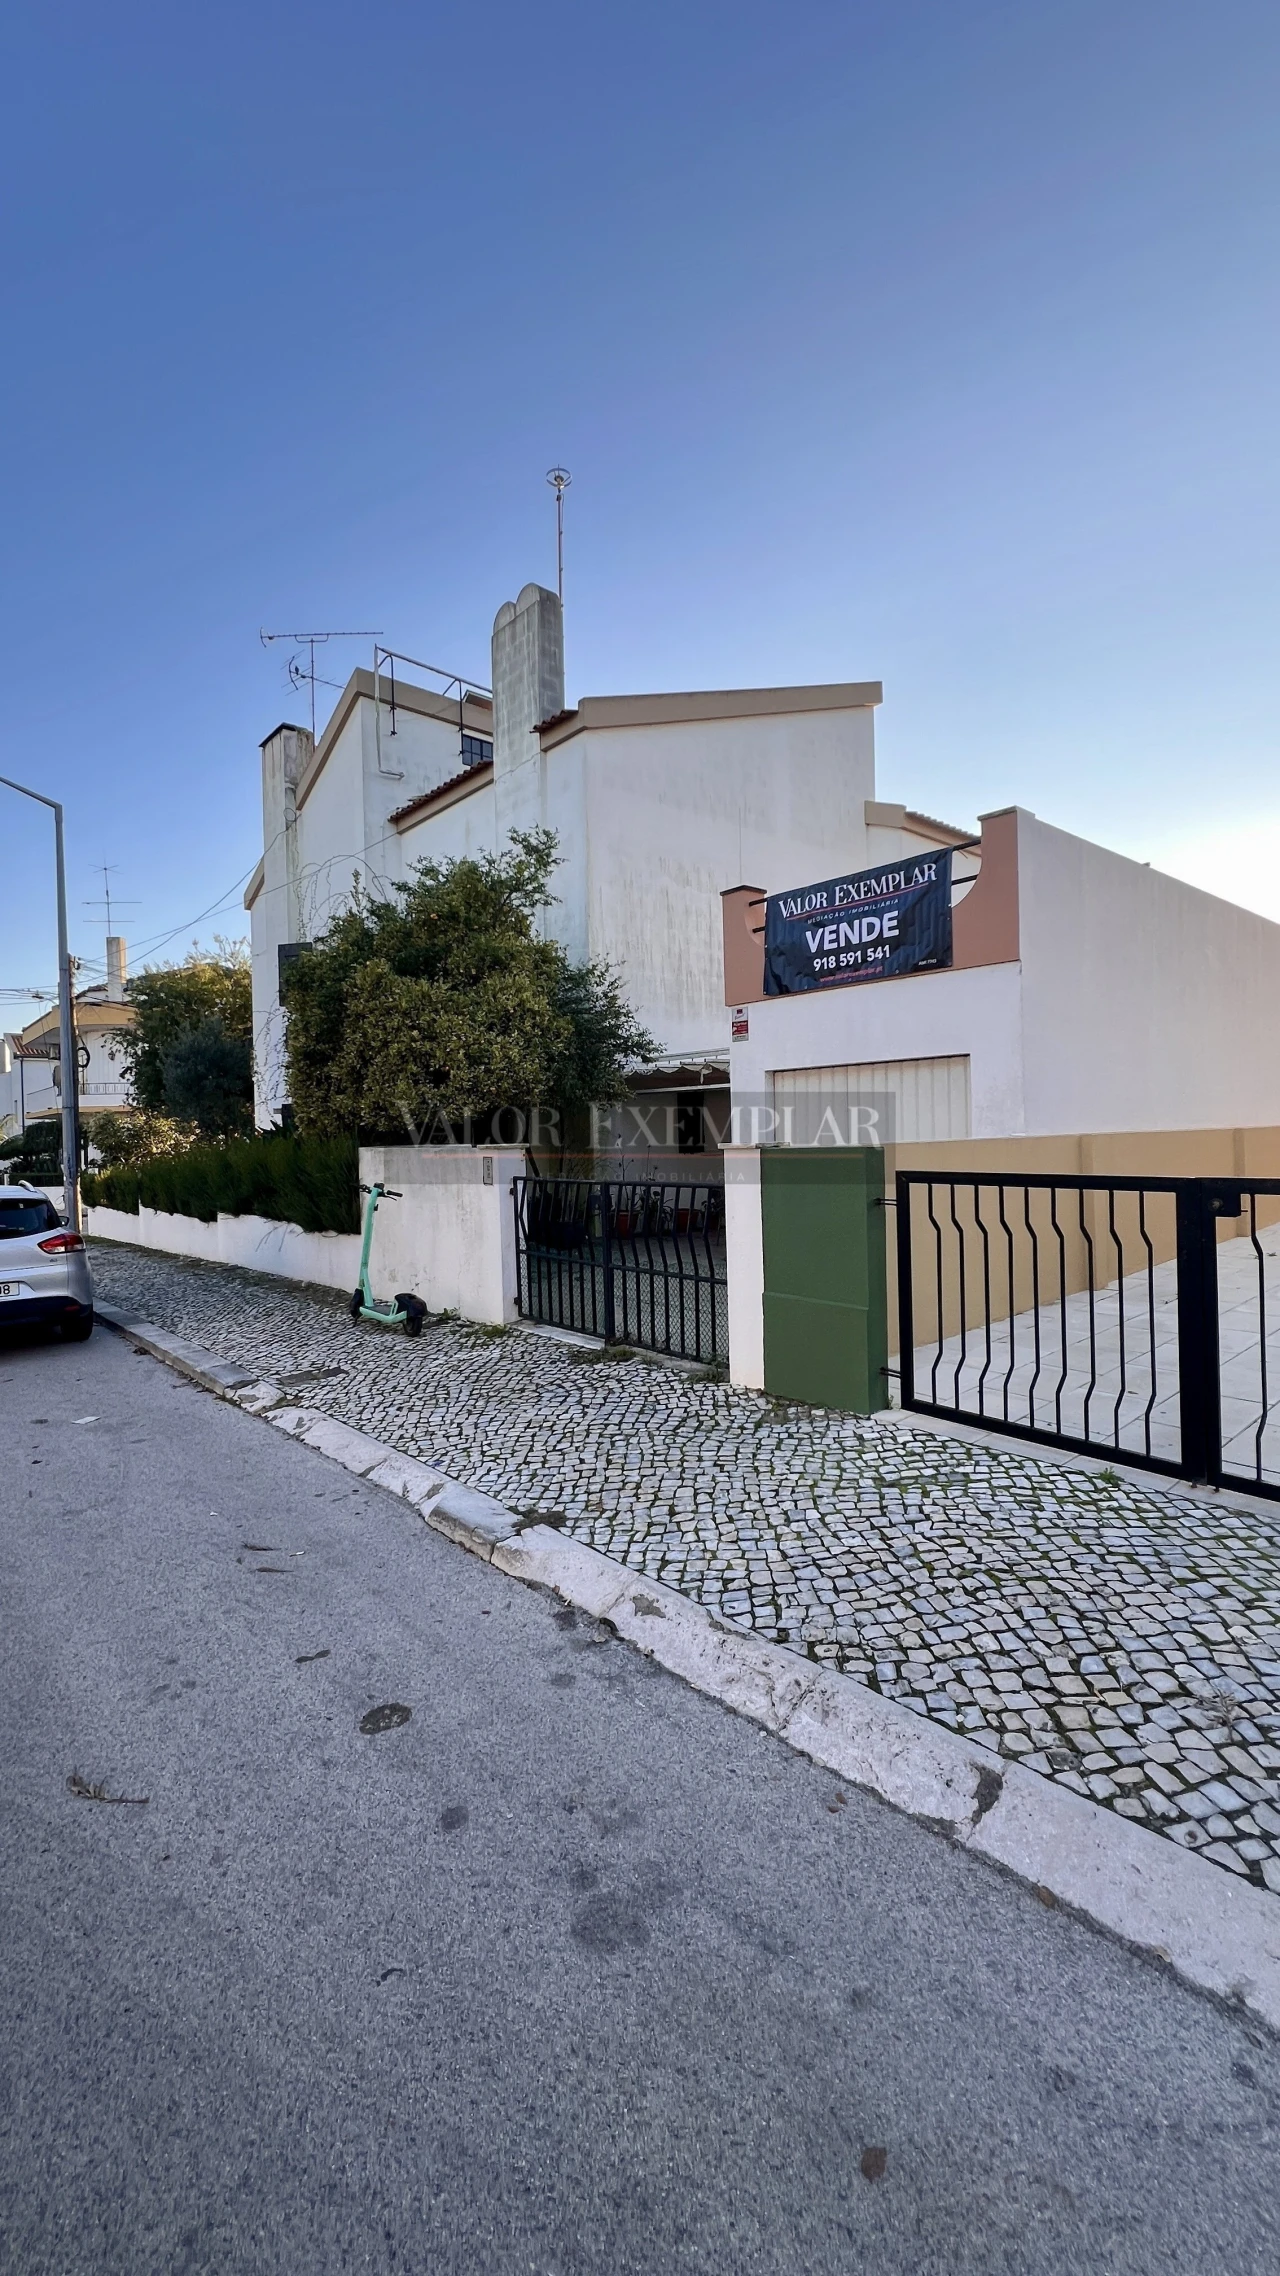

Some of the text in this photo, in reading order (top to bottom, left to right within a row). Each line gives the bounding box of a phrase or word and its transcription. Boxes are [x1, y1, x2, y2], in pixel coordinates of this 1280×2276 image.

[778, 863, 937, 918] VALOR EXEMPLAR
[807, 898, 899, 925] MEDIAÇÃO IMOBILIÁRIA
[805, 910, 900, 953] VENDE
[813, 945, 891, 971] 918 591 541
